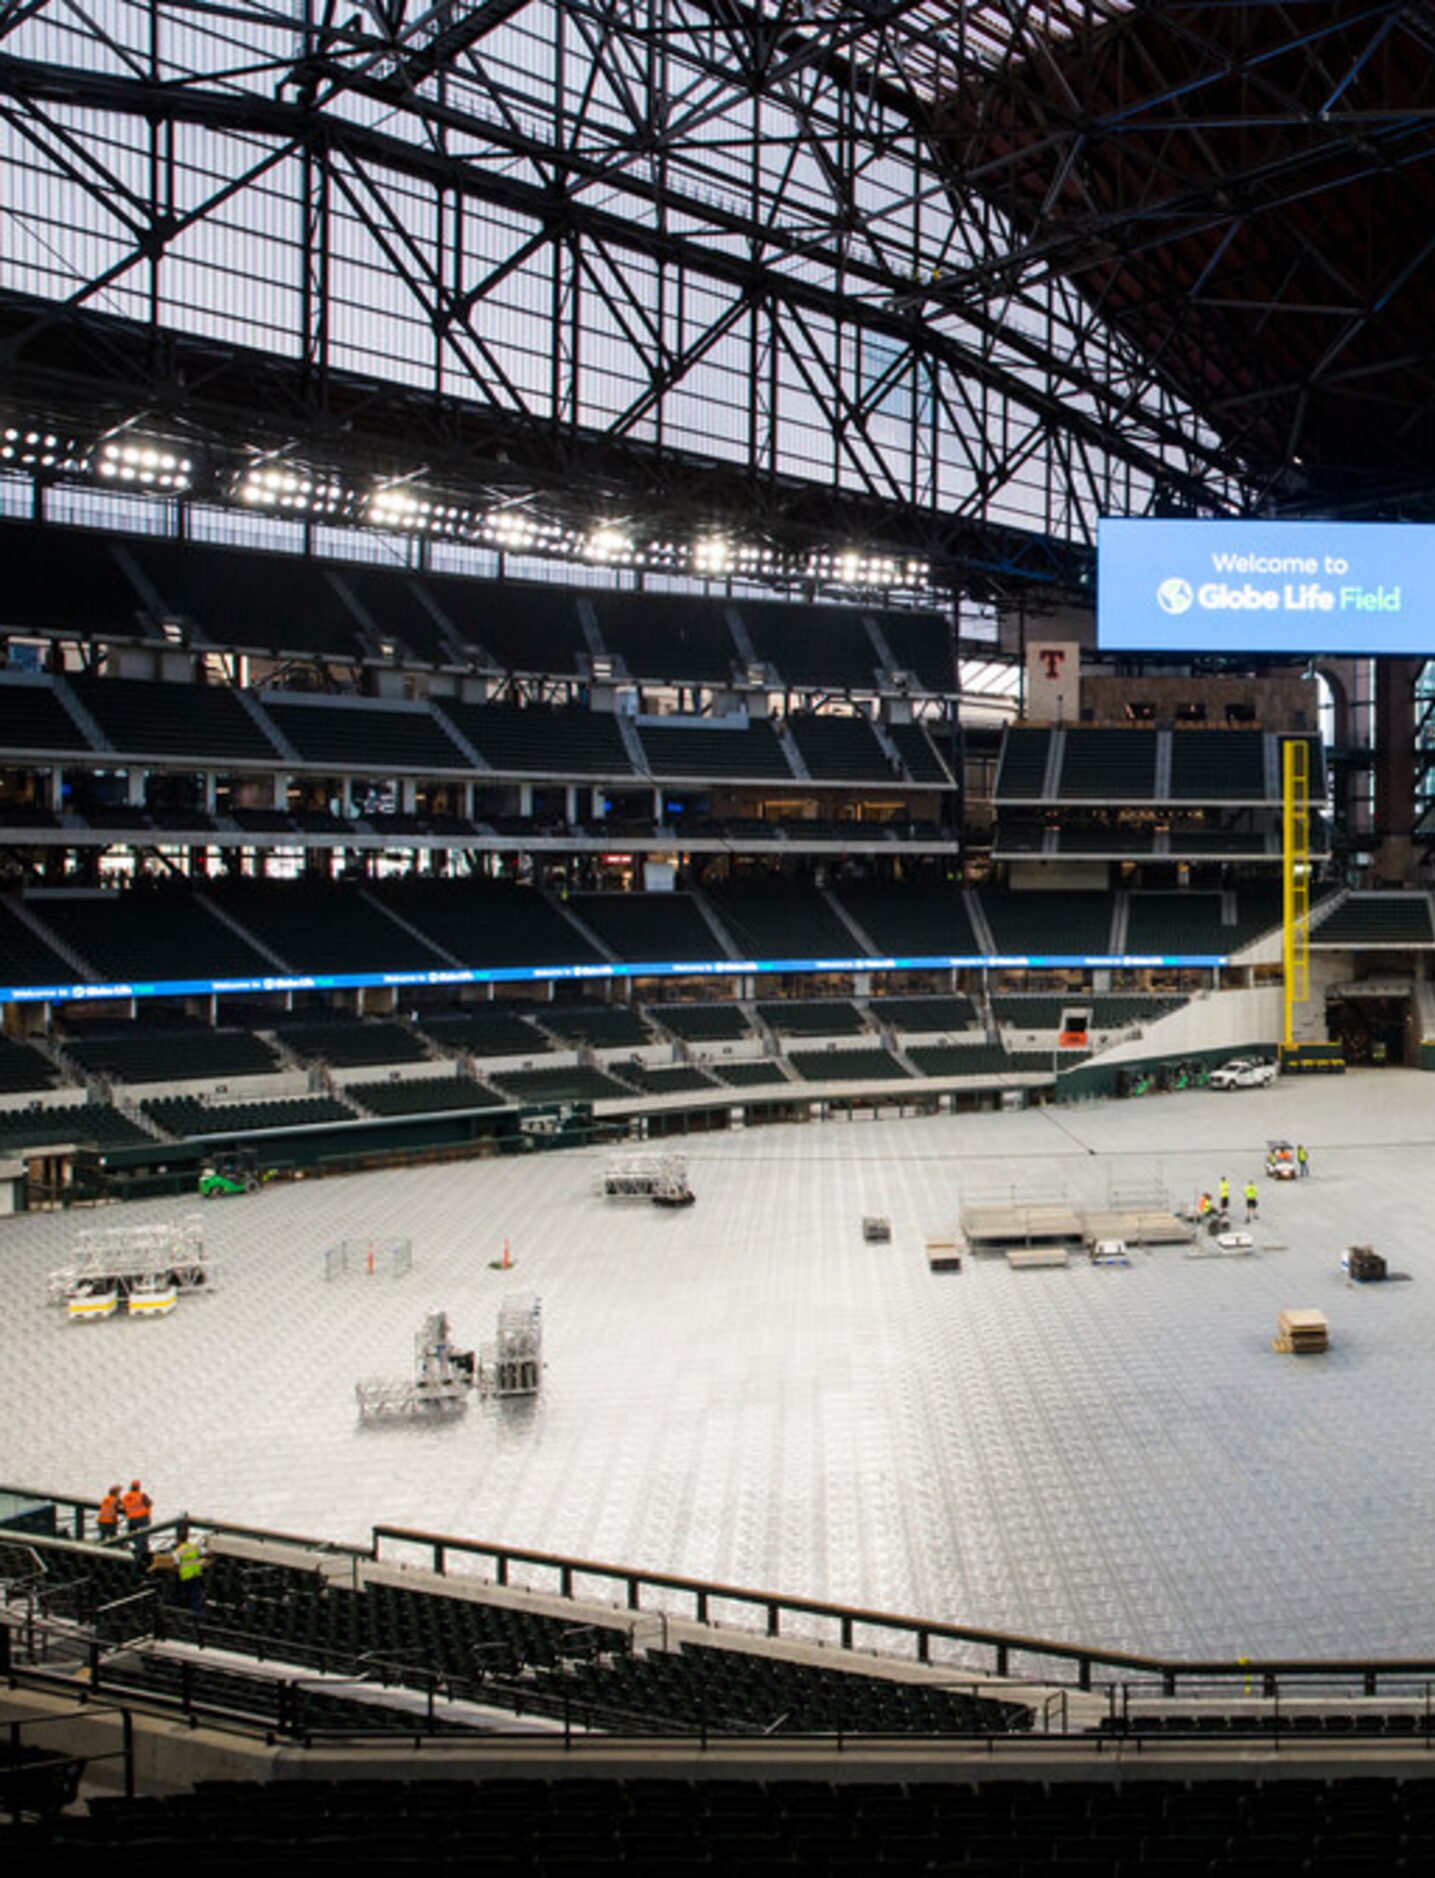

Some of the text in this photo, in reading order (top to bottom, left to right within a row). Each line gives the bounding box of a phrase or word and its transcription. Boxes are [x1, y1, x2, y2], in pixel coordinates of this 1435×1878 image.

[1211, 552, 1349, 574] Welcome to
[1199, 583, 1401, 612] Globe Life Field
[1039, 649, 1065, 680] T
